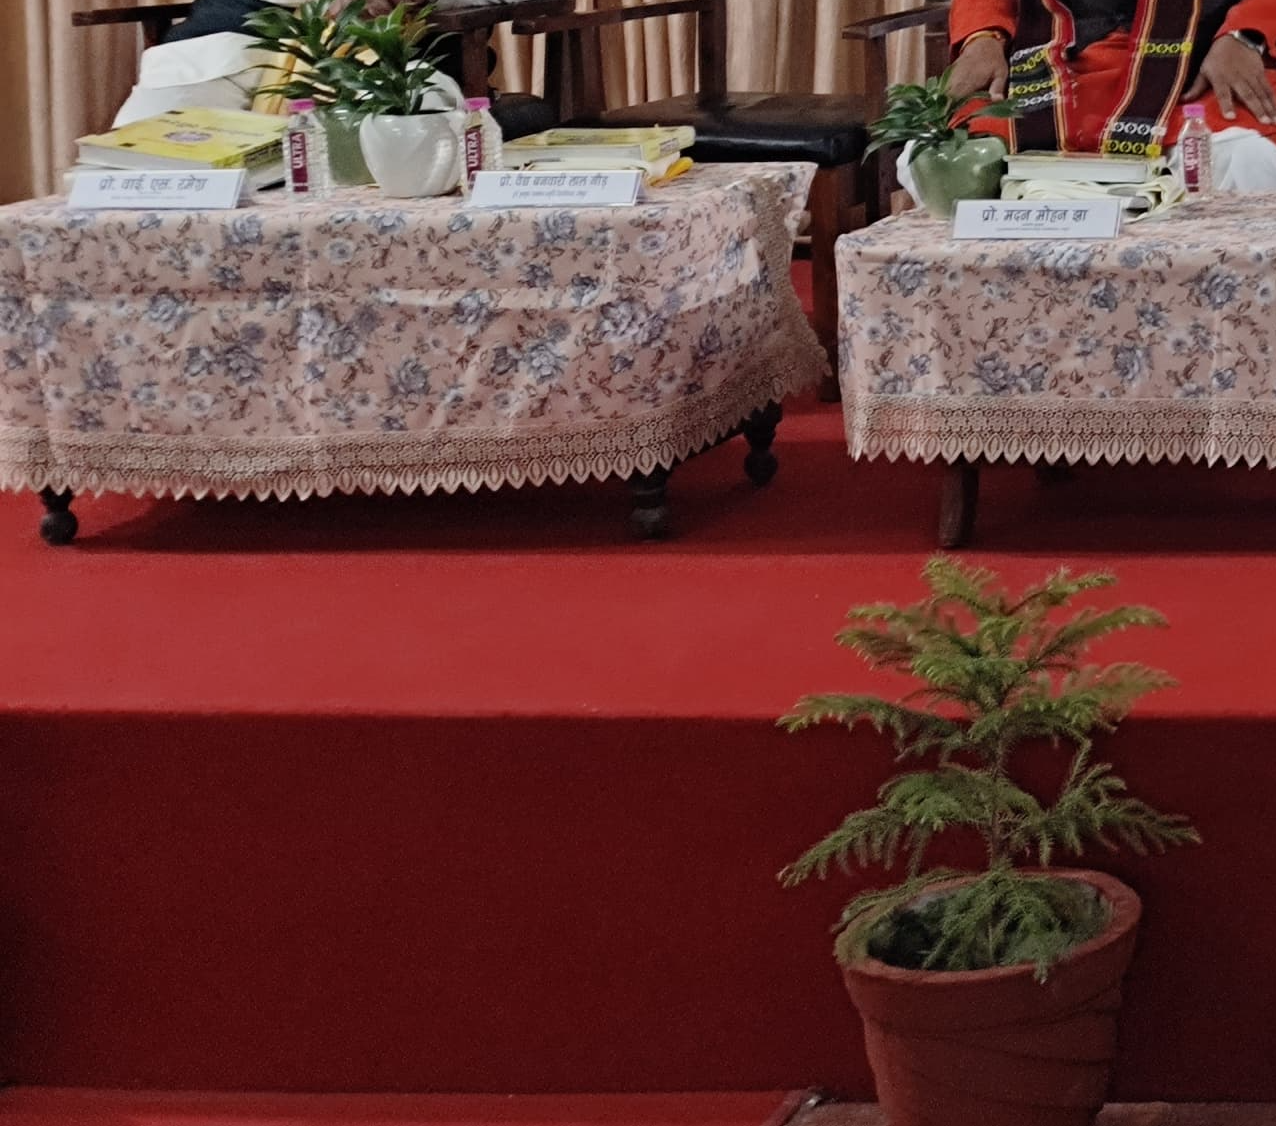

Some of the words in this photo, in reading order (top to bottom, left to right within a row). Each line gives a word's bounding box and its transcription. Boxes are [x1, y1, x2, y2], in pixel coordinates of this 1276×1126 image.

[291, 132, 305, 169] ULTRA
[467, 131, 478, 168] ULTRA
[1003, 209, 1032, 222] मदन
[1036, 204, 1068, 222] मोहन
[1072, 209, 1089, 223] झा
